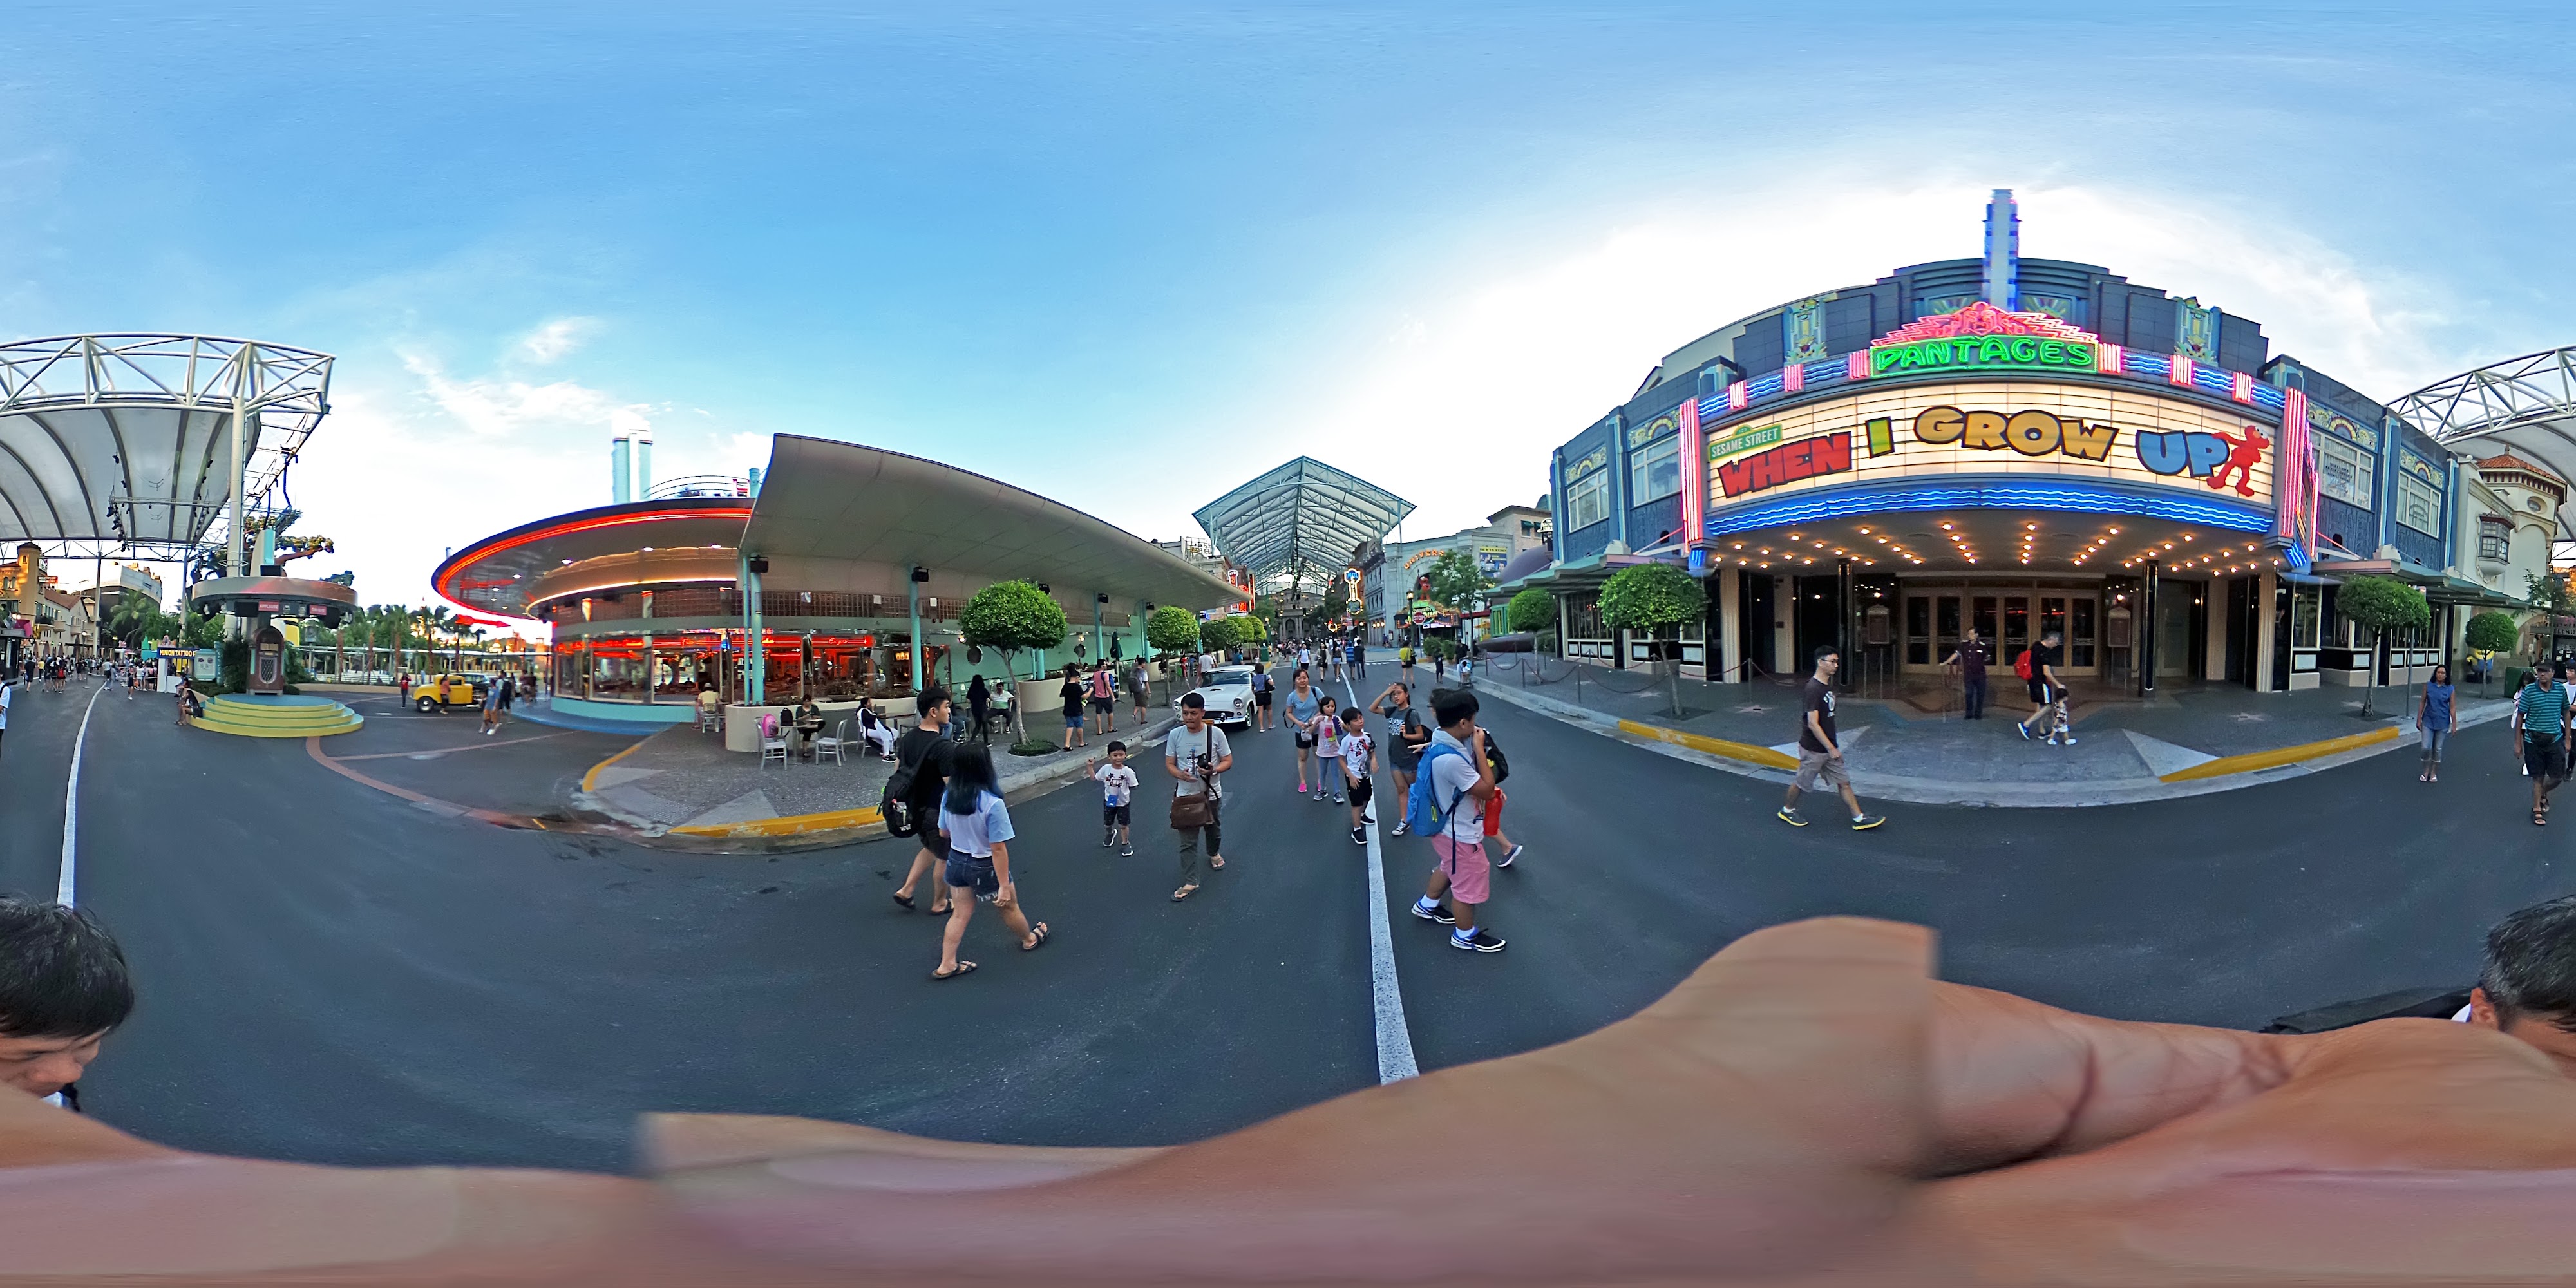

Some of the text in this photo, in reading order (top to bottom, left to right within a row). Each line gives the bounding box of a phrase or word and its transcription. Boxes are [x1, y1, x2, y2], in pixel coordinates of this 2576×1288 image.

[1876, 337, 2092, 372] PANTAGES
[1711, 428, 1779, 457] SESAME STREET
[1718, 405, 2230, 499] WHEN I GROW UP
[1403, 549, 1444, 570] UNIVERS
